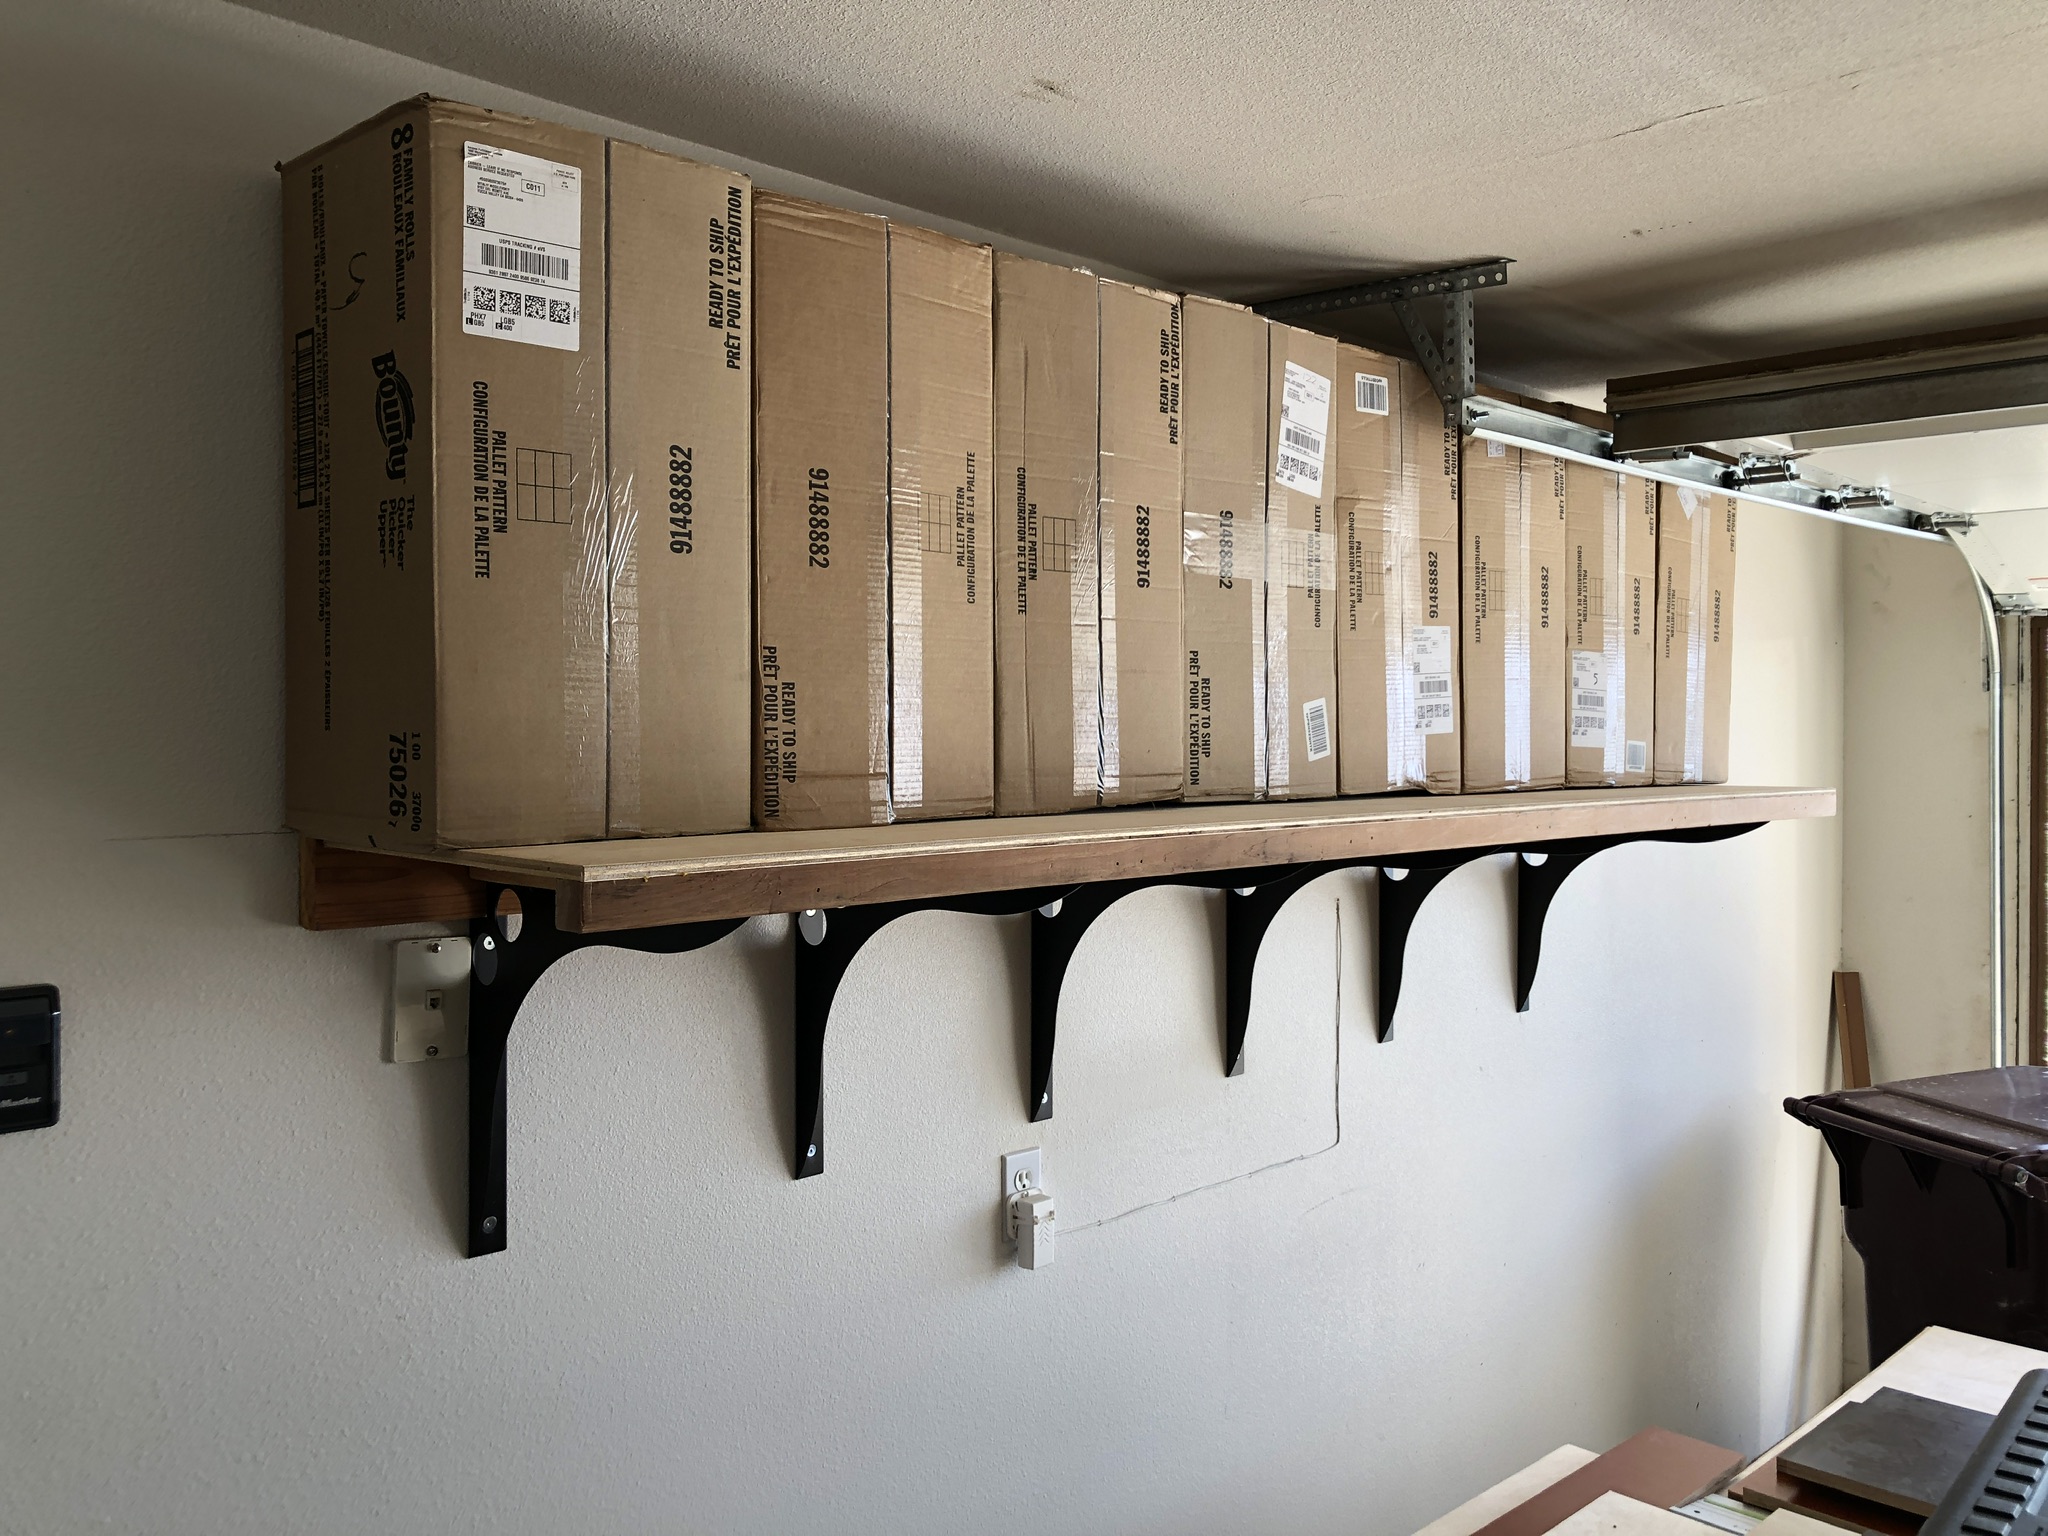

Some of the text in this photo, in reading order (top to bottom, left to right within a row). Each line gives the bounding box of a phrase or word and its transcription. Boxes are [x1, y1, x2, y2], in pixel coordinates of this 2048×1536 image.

[390, 127, 405, 323] 8 ROULEAUX FAMILIAUX
[402, 123, 415, 262] 8 FAMILY ROLLS
[313, 254, 321, 287] TOTAL
[498, 238, 511, 246] USPS
[511, 240, 533, 250] TRACKING
[709, 217, 724, 329] READY TO SHIP
[724, 186, 742, 370] PRÊT POUR L'EXPÉDITION
[1159, 328, 1170, 414] READY TO SHIP
[1168, 303, 1181, 445] PRÊT POUR L'EXPÉDITION
[372, 350, 409, 481] Bounty
[1444, 432, 1451, 444] TO
[472, 380, 490, 579] CONFIGURATION DE LA PALETTE
[492, 430, 508, 534] PALLET PATTERN
[669, 444, 692, 554] 91488882
[1554, 457, 1559, 468] TO
[387, 498, 397, 558] Picker
[396, 496, 406, 571] Quicker
[406, 494, 415, 532] The
[808, 467, 830, 569] 91488882
[956, 486, 965, 567] PALLET PATTERN
[966, 451, 976, 604] CONFIGURATION DE LA PALETTE
[1016, 466, 1027, 615] CONFIGURATION DE LA PALETTE
[1027, 503, 1037, 581] PALLET PATTERN
[1136, 504, 1150, 588] 91488882
[1219, 510, 1233, 590] 91488882
[1314, 540, 1321, 551] LA
[1314, 552, 1321, 563] DE
[1348, 511, 1357, 632] CONFIGURATION DE LA PALETTE
[1428, 551, 1439, 619] 91488882
[1475, 593, 1480, 602] DE
[1541, 566, 1549, 628] 91488882
[1475, 604, 1480, 613] LA
[1577, 598, 1582, 607] DE
[1577, 608, 1582, 617] LA
[1633, 578, 1641, 635] 91488882
[1713, 589, 1721, 643] 91488882
[324, 669, 332, 731] ÉPAISSEURS
[763, 645, 782, 819] PRÊT POUR L'EXPÉDITION
[781, 681, 797, 784] READY TO SHIP
[1189, 650, 1201, 786] PRÊT POUR L'EXPÉDITION
[1201, 677, 1211, 758] READY TO SHIP
[388, 732, 407, 818] 75026
[411, 743, 422, 761] 00
[411, 792, 423, 832] 37000
